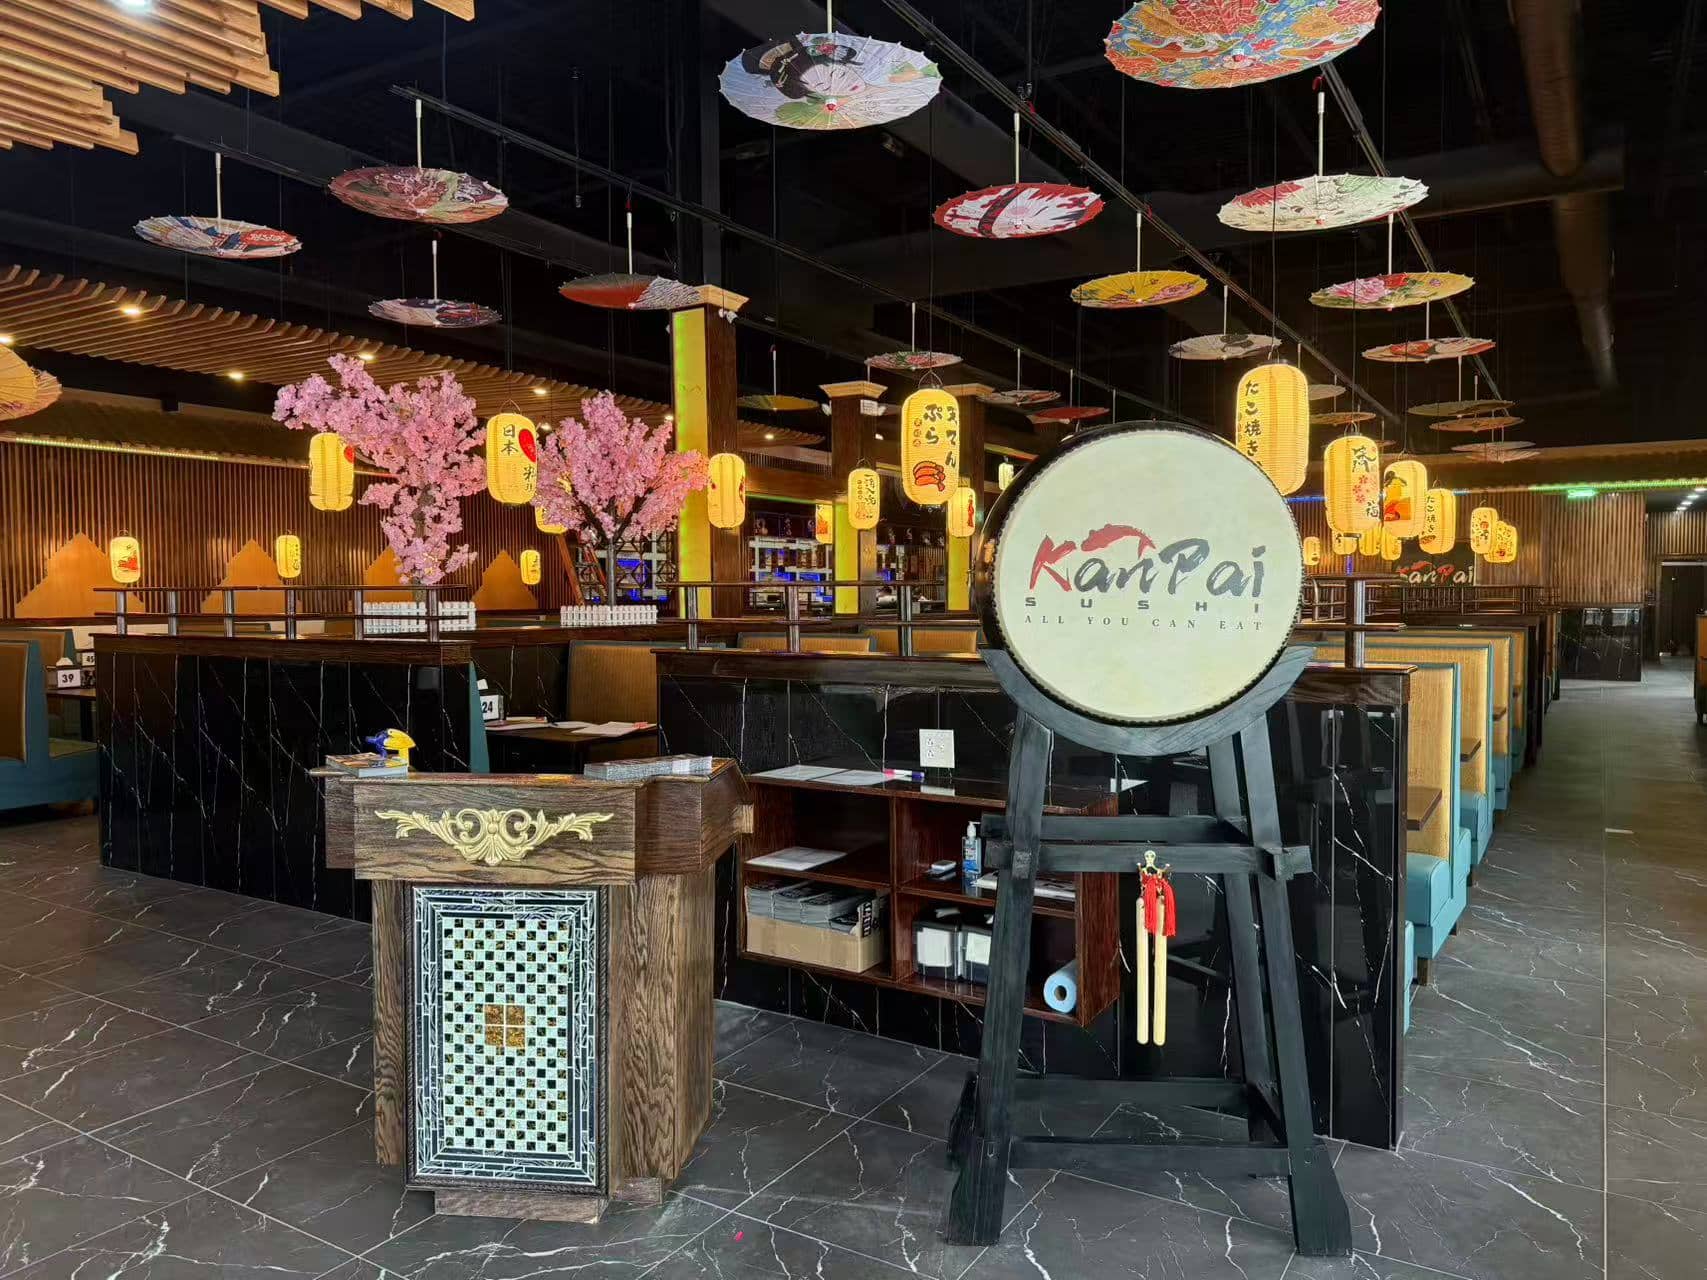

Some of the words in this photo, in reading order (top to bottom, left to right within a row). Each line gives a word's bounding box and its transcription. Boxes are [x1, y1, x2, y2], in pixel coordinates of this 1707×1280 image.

[500, 424, 519, 456] 日本
[1029, 532, 1266, 597] KanPai
[1025, 597, 1260, 613] SUSHI
[1025, 615, 1065, 625] ALL
[1087, 617, 1130, 627] YOU
[1152, 619, 1196, 629] CAN
[1219, 620, 1262, 631] EAT
[62, 673, 74, 683] 39
[481, 701, 493, 713] 24
